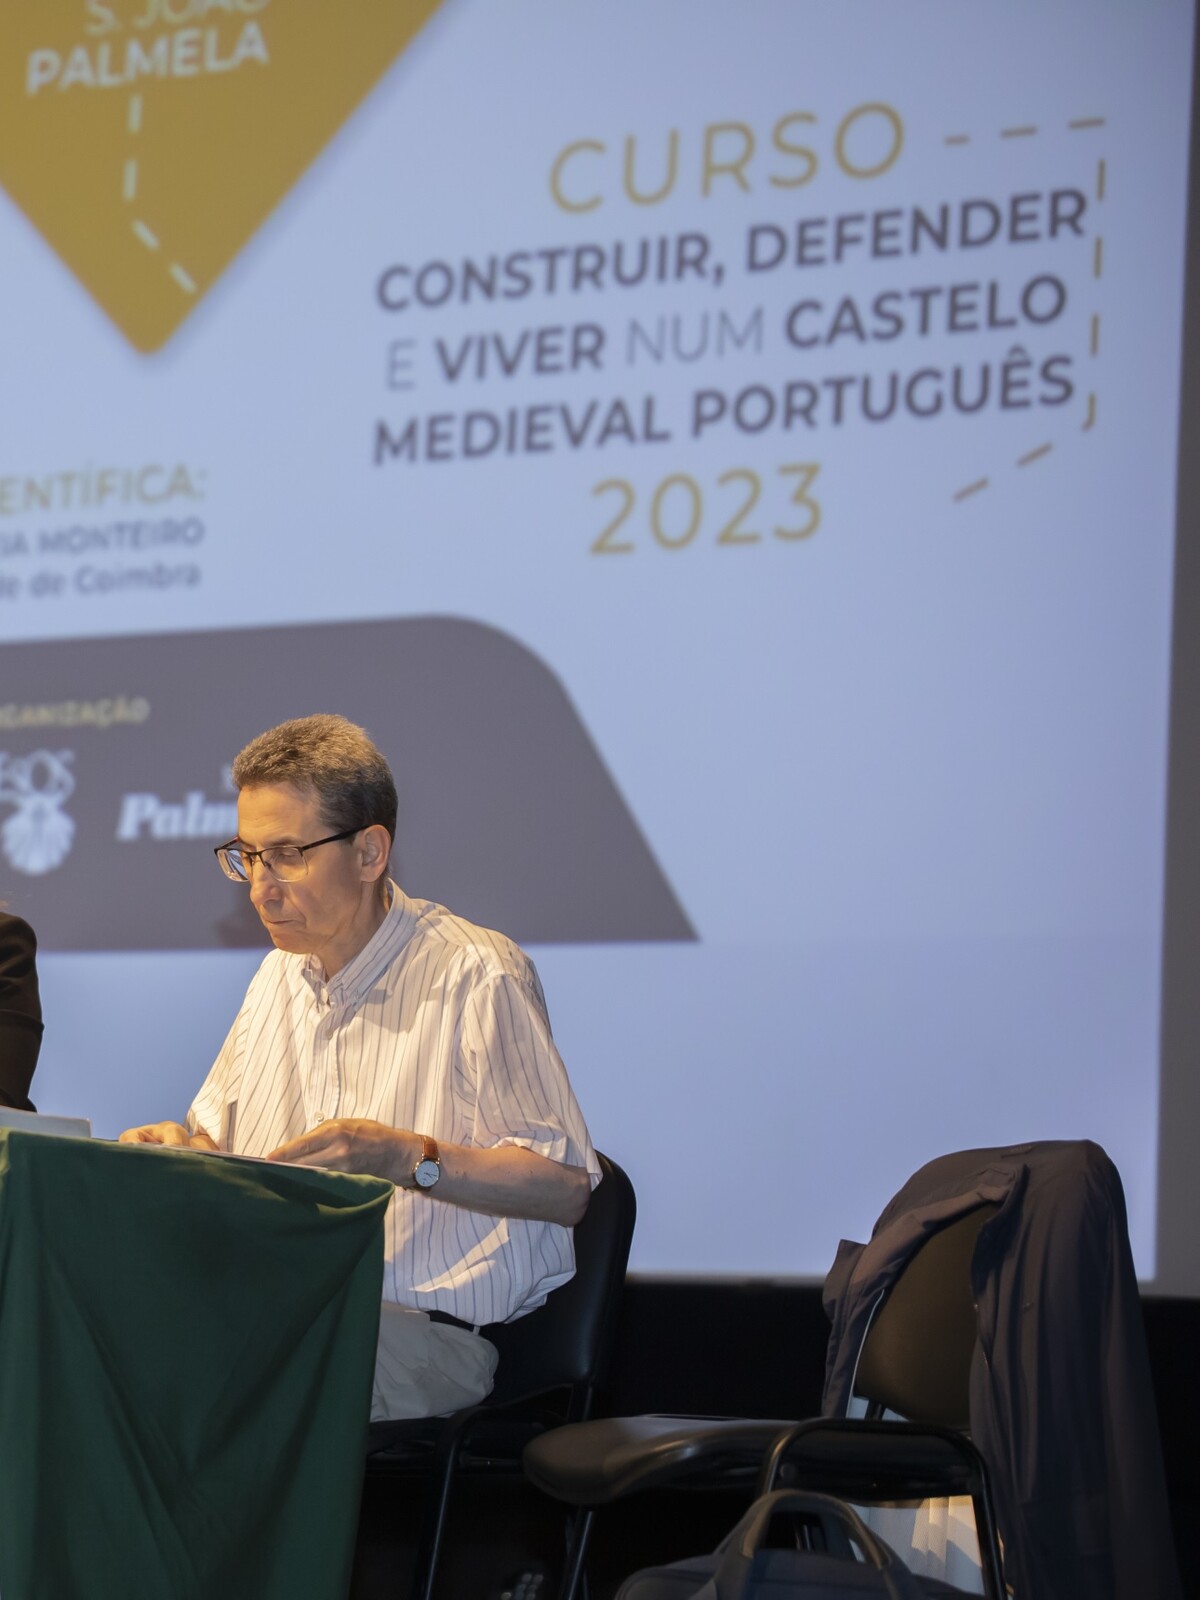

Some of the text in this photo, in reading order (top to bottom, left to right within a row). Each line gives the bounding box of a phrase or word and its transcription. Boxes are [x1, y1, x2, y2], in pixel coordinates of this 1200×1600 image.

[26, 20, 270, 96] PALMELA
[549, 102, 905, 214] CURSO
[376, 188, 1088, 313] CONSTRUIR, DEFENDER
[387, 274, 1067, 391] E VIVER NUM CASTELO
[373, 344, 1076, 466] MEDIEVAL PORTUGUÊS
[590, 461, 824, 556] 2023
[116, 791, 240, 842] Palm
